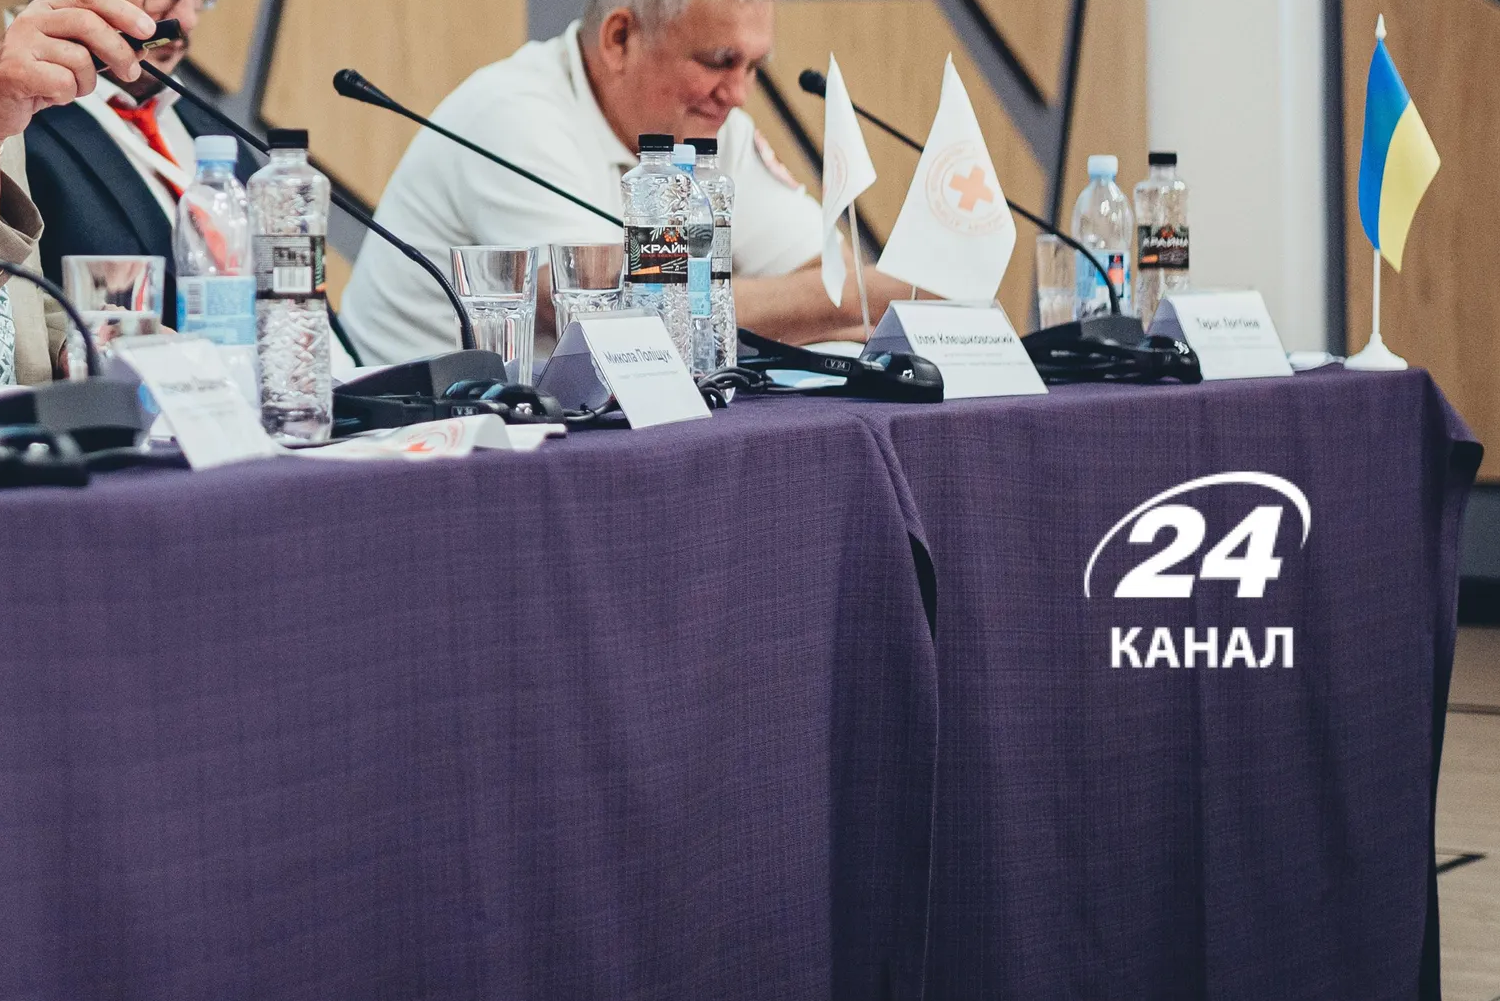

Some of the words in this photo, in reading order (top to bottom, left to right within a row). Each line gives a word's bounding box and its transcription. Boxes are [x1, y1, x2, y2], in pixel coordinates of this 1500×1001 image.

[640, 242, 688, 254] КРАЙН
[603, 350, 638, 364] Микола
[634, 346, 673, 363] Поліщук
